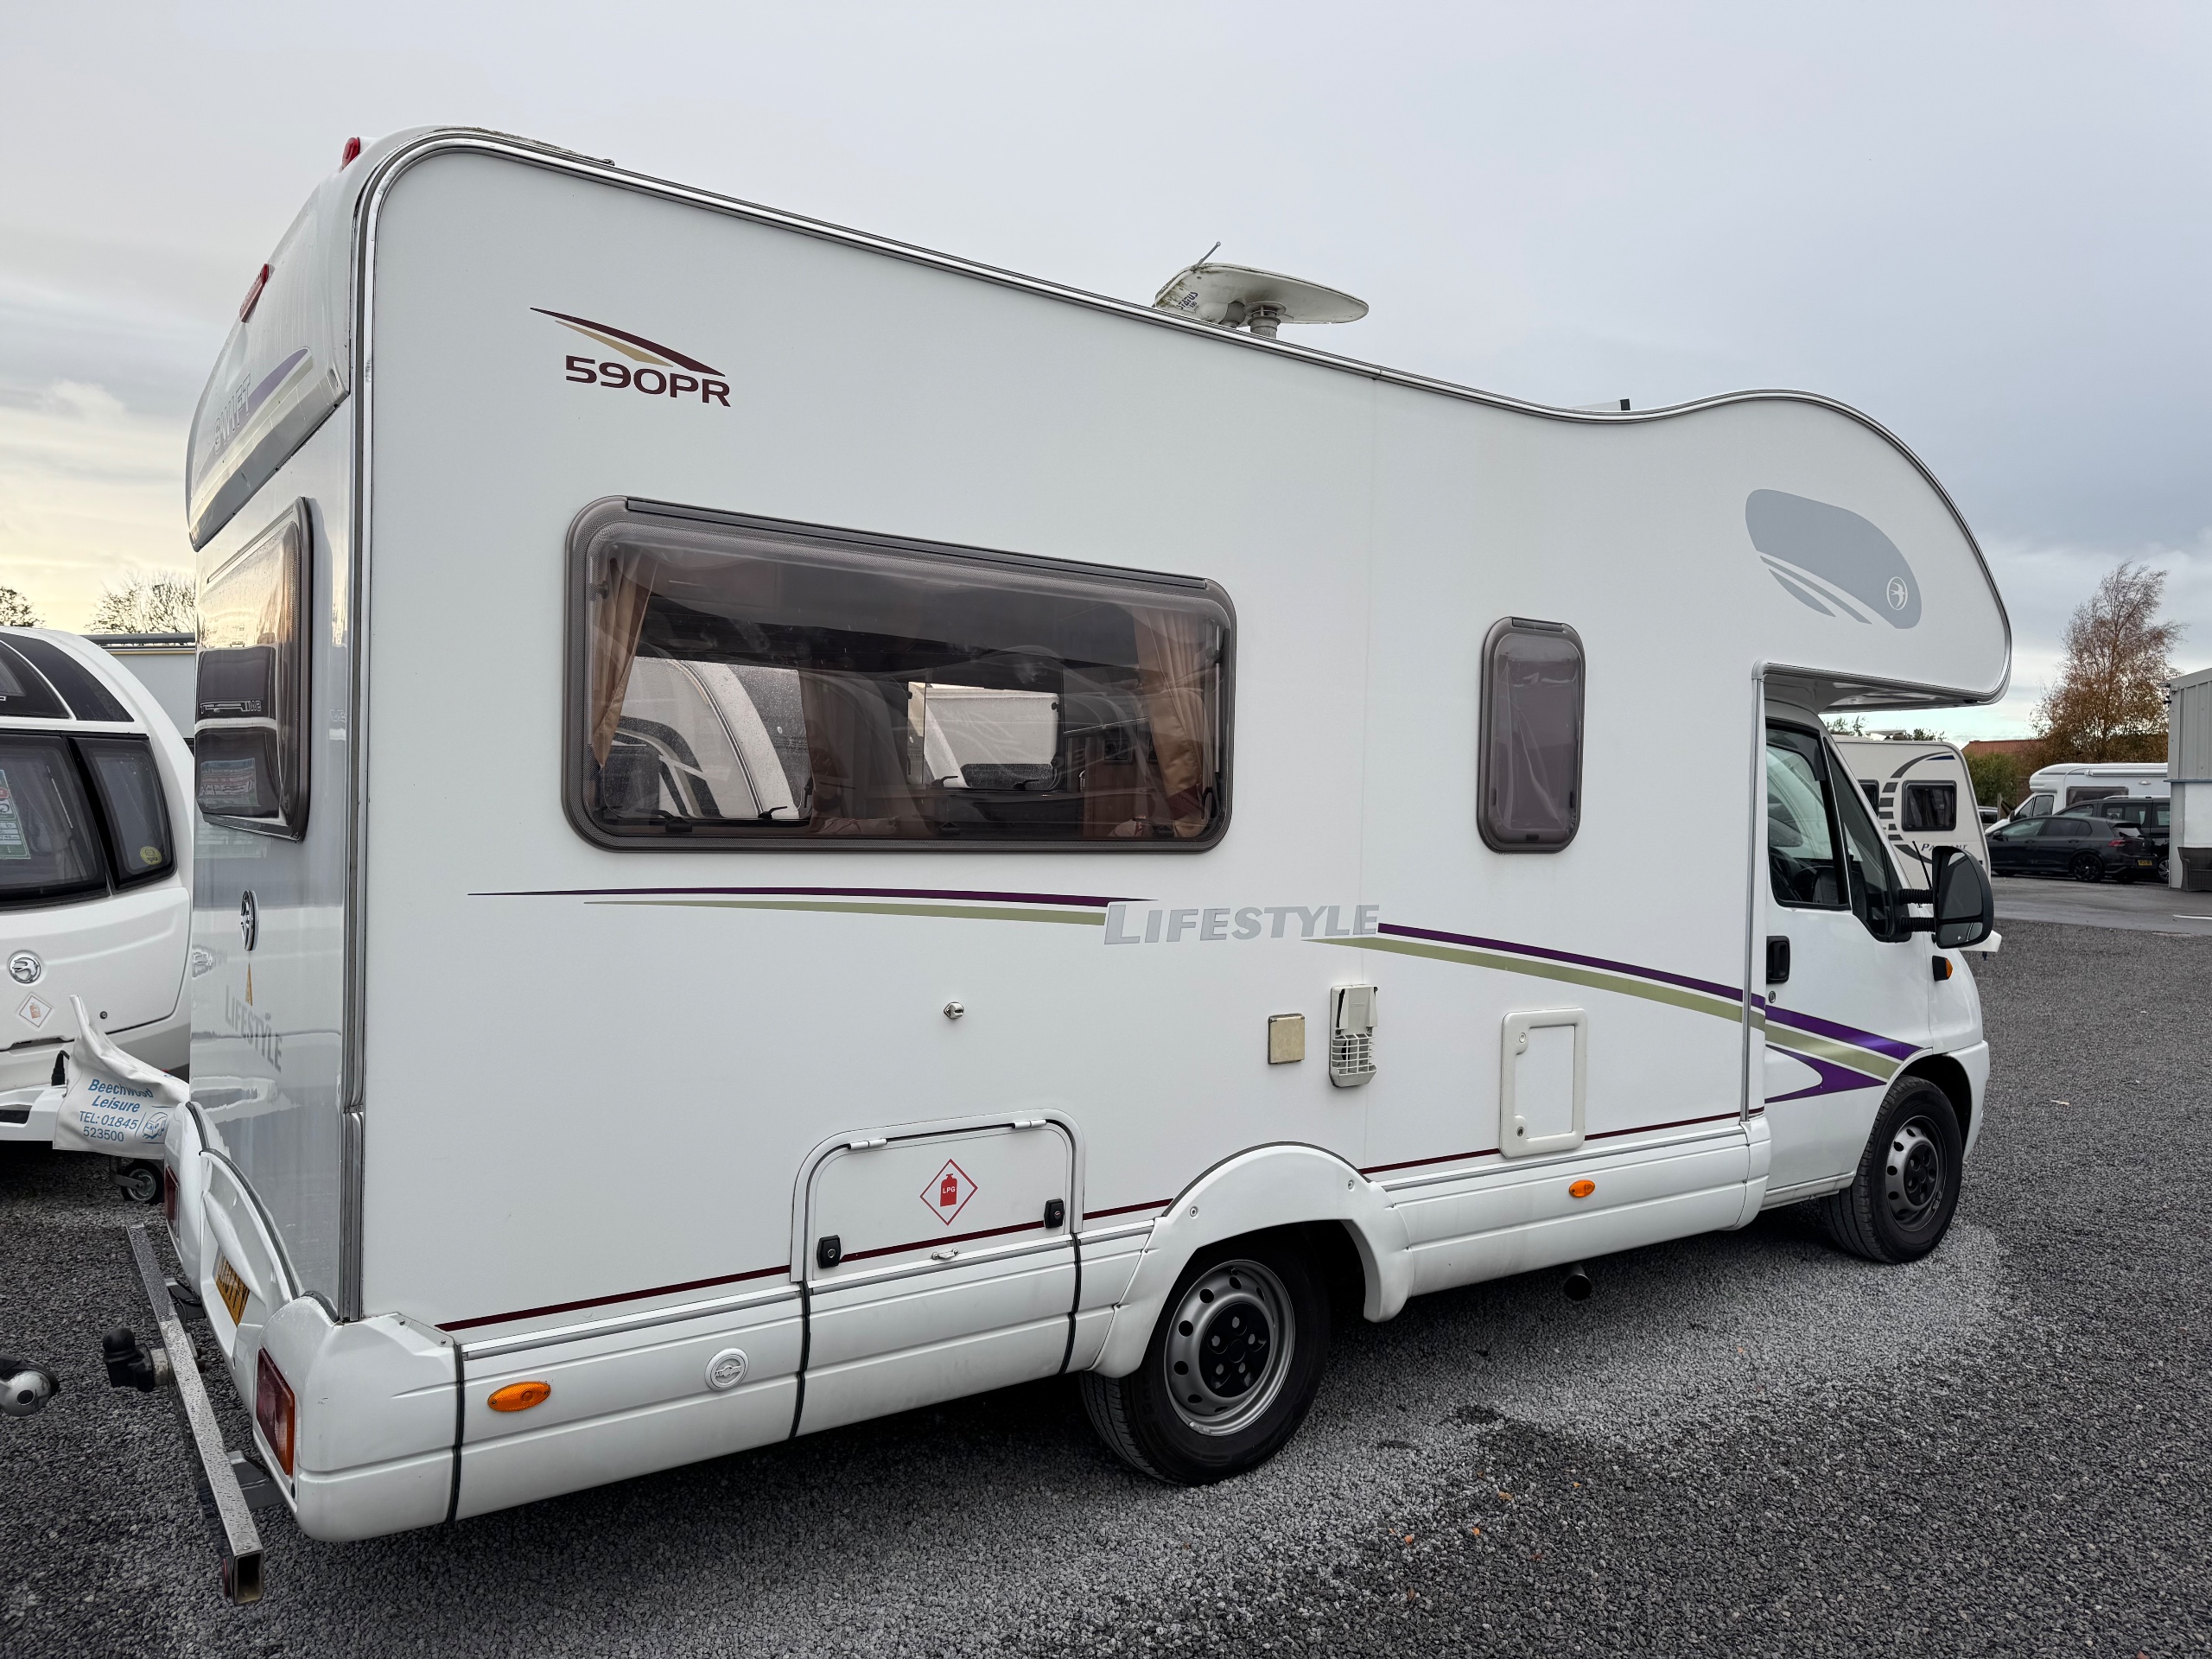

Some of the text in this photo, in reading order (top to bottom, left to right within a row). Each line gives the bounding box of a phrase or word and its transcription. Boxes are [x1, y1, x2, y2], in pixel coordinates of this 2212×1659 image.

[1176, 291, 1198, 309] STATUS
[565, 354, 732, 408] 590PR
[214, 372, 251, 455] SWIFT
[1104, 905, 1380, 944] LIFESTYLE
[225, 984, 282, 1074] LIFESTYLE
[92, 1095, 141, 1113] Leisure
[79, 1110, 139, 1130] TEL: 01845
[83, 1126, 124, 1142] 523500
[942, 1185, 956, 1194] LPG
